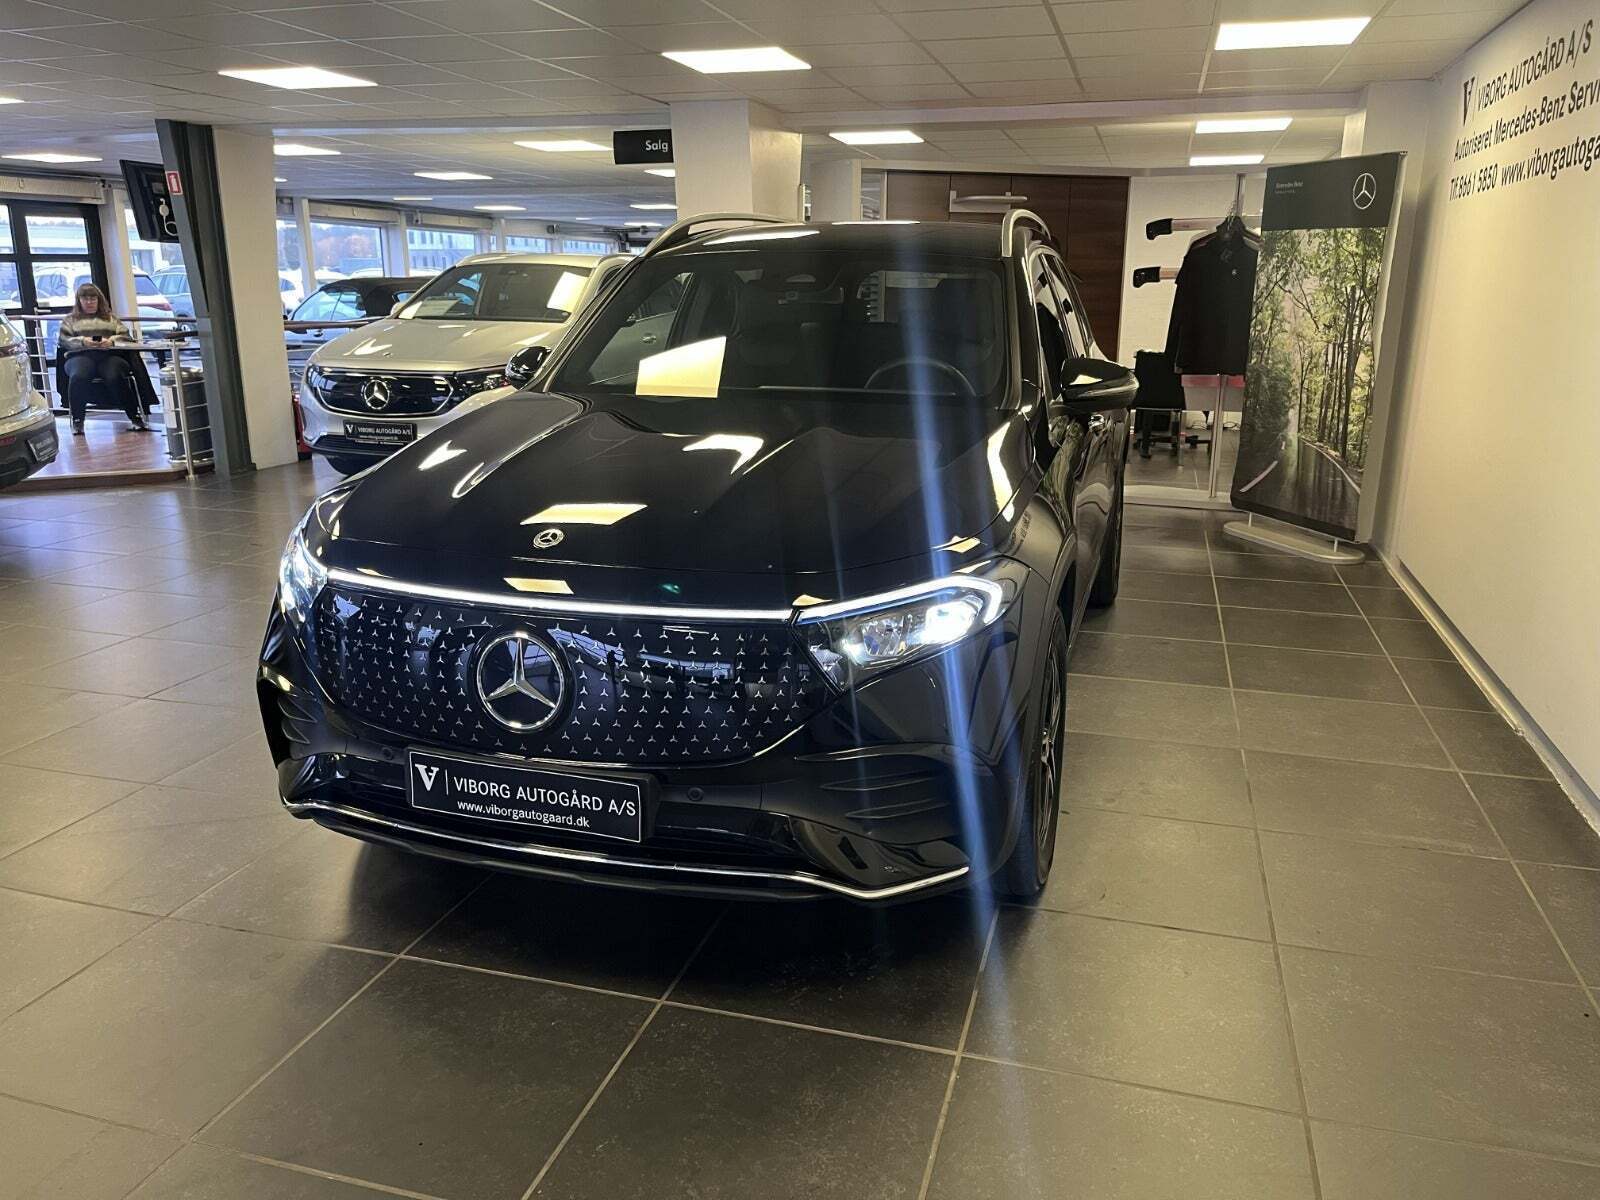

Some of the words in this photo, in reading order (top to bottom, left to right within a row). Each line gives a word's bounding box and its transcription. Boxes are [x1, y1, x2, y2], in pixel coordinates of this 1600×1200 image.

[1477, 73, 1508, 112] VIBORG
[1509, 36, 1565, 93] AUTOGÅRD
[1566, 19, 1594, 69] A/S
[1454, 126, 1493, 162] Autoriseret
[1494, 93, 1566, 145] Mercedes-Benz
[645, 139, 669, 153] Salg
[1477, 163, 1498, 193] 5850
[453, 776, 511, 799] VIBORG
[516, 786, 603, 811] AUTOGÅRD
[608, 799, 636, 817] A/S
[457, 800, 590, 828] www.viborgautogaard.dk
